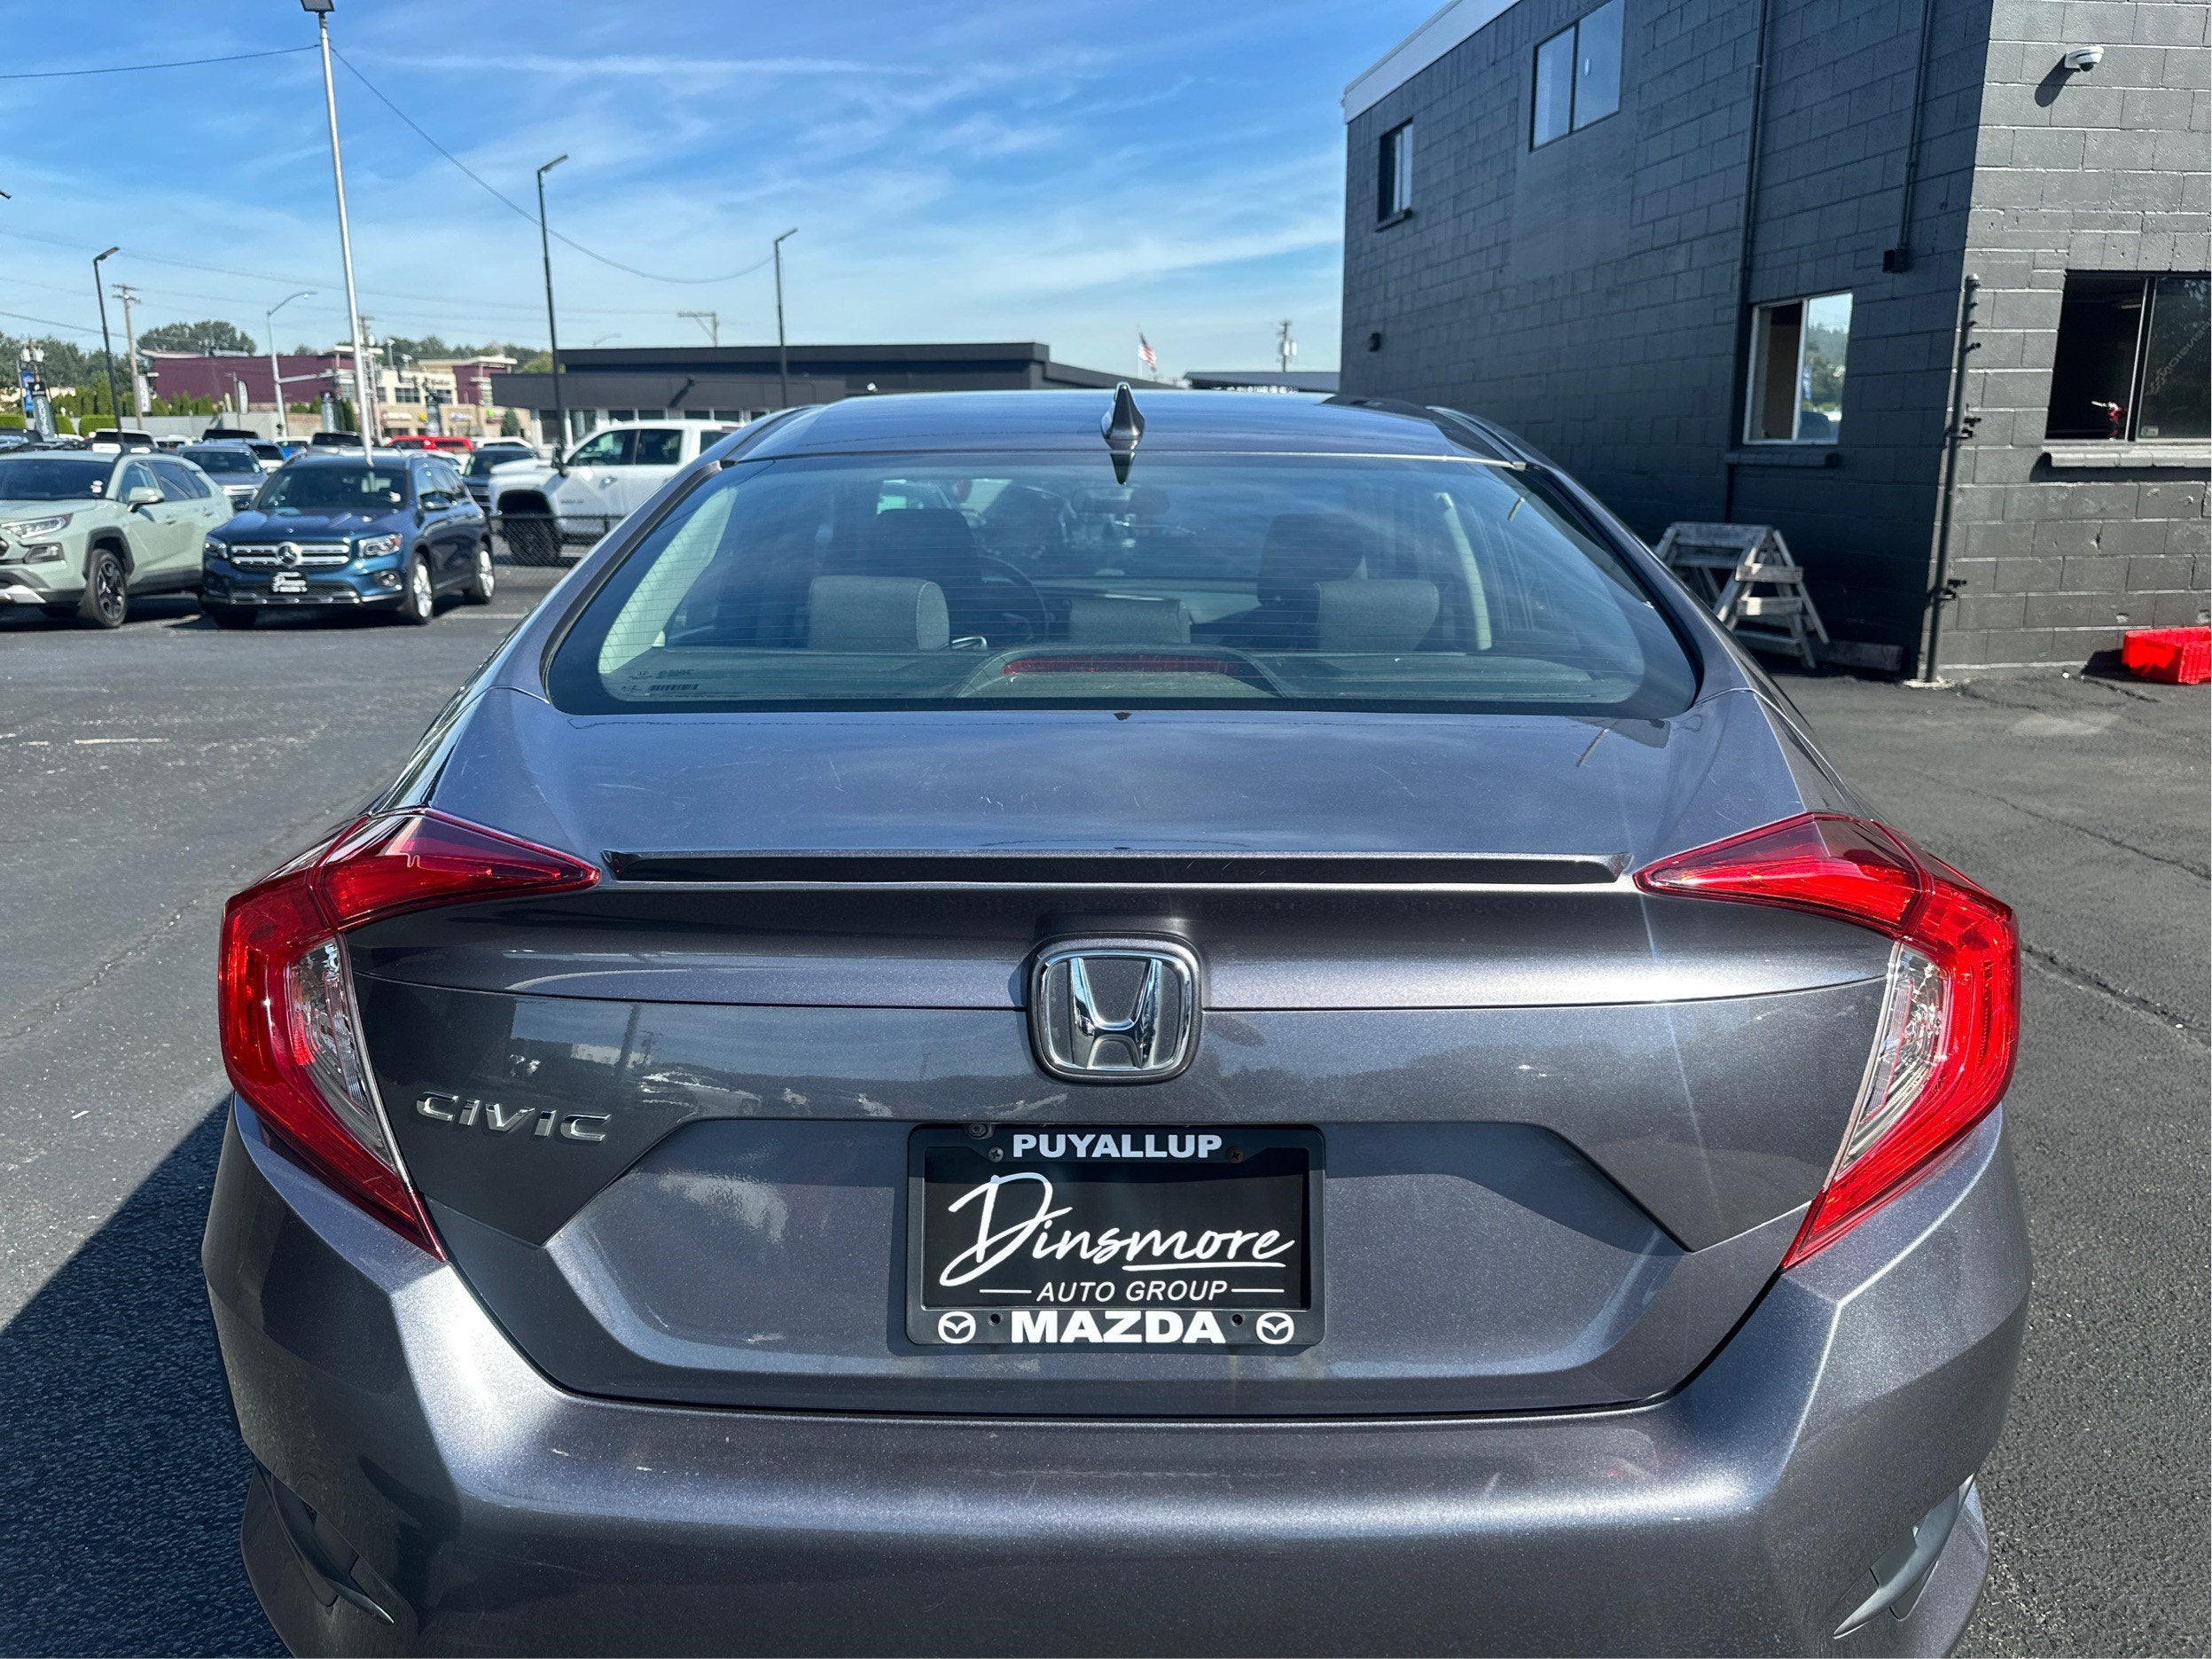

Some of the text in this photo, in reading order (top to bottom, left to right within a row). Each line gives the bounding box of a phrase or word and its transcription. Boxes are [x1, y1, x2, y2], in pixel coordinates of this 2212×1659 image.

[416, 1091, 612, 1142] CIVIC
[1012, 1133, 1223, 1159] PUYALLUP
[939, 1171, 1295, 1287] Dinsmore
[1036, 1279, 1228, 1303] AUTO GROUP
[1011, 1310, 1226, 1343] MAZDA
